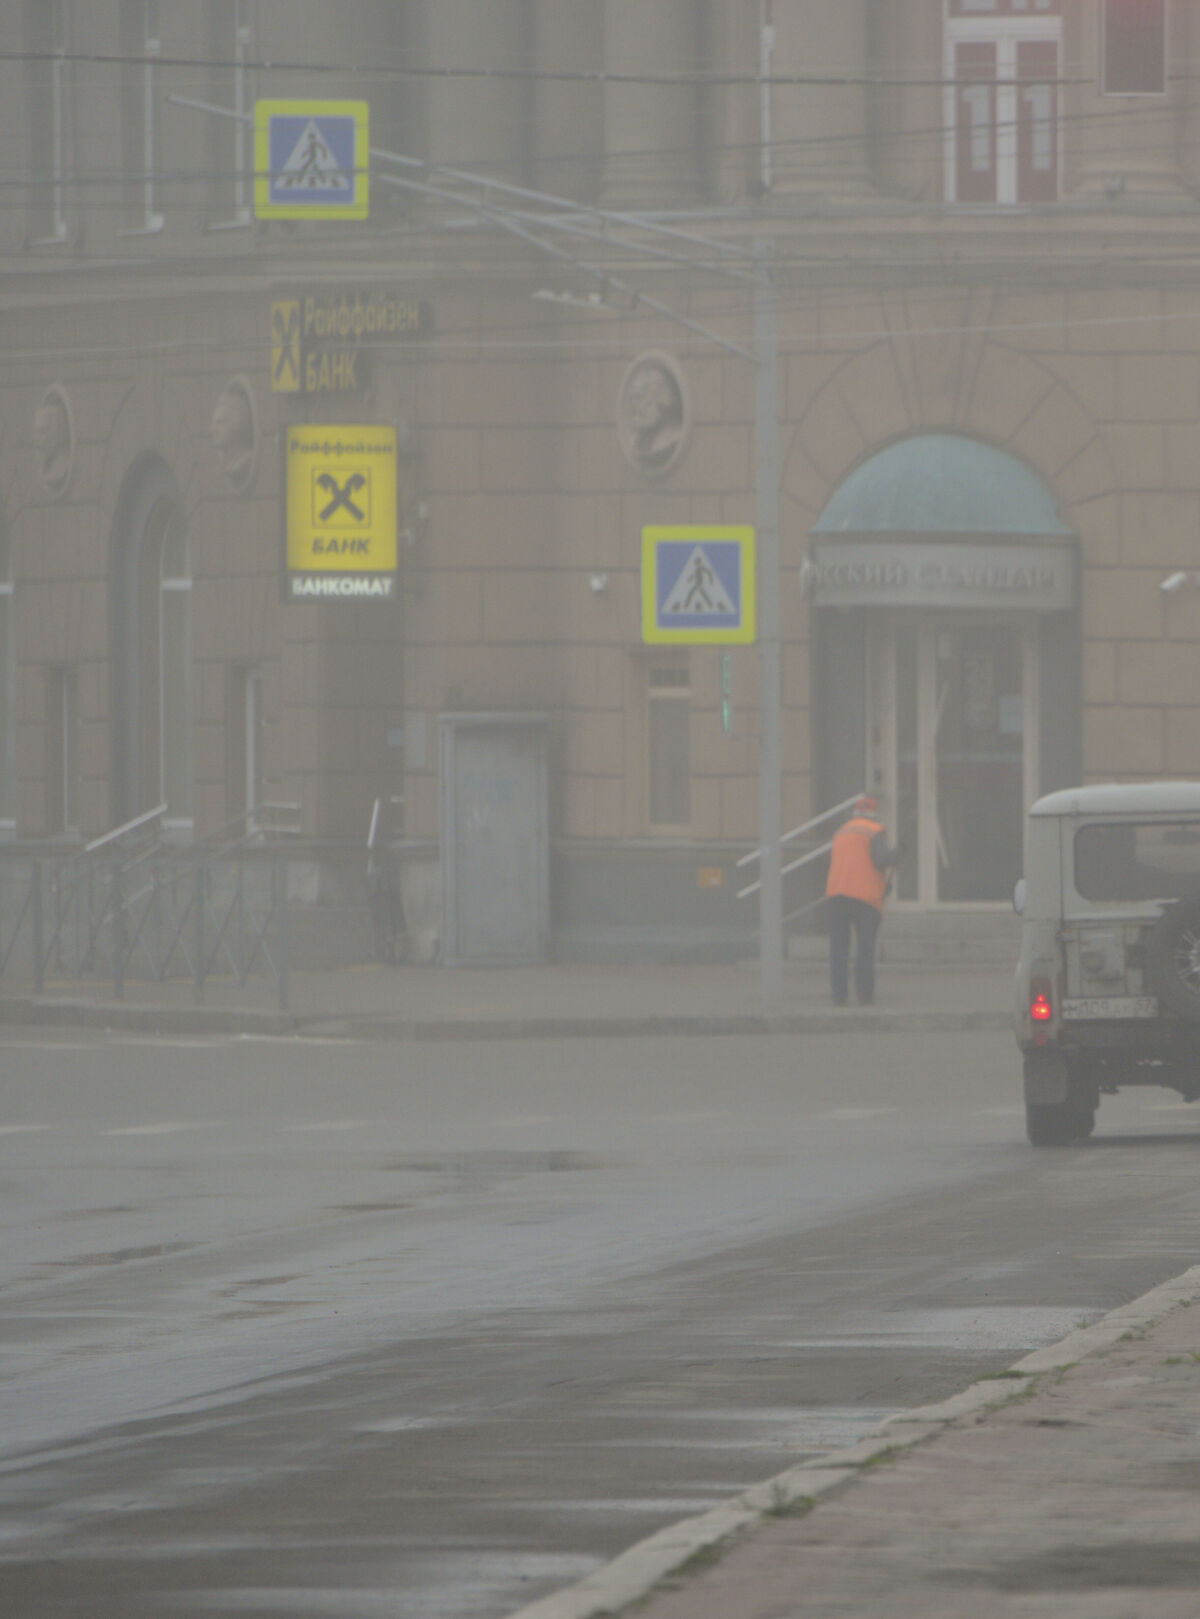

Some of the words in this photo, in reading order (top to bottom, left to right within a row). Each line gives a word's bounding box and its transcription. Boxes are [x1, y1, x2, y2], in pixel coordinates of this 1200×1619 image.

[306, 350, 358, 392] БАНК
[311, 537, 371, 555] БАНК
[292, 576, 392, 595] БАНКОМАТ
